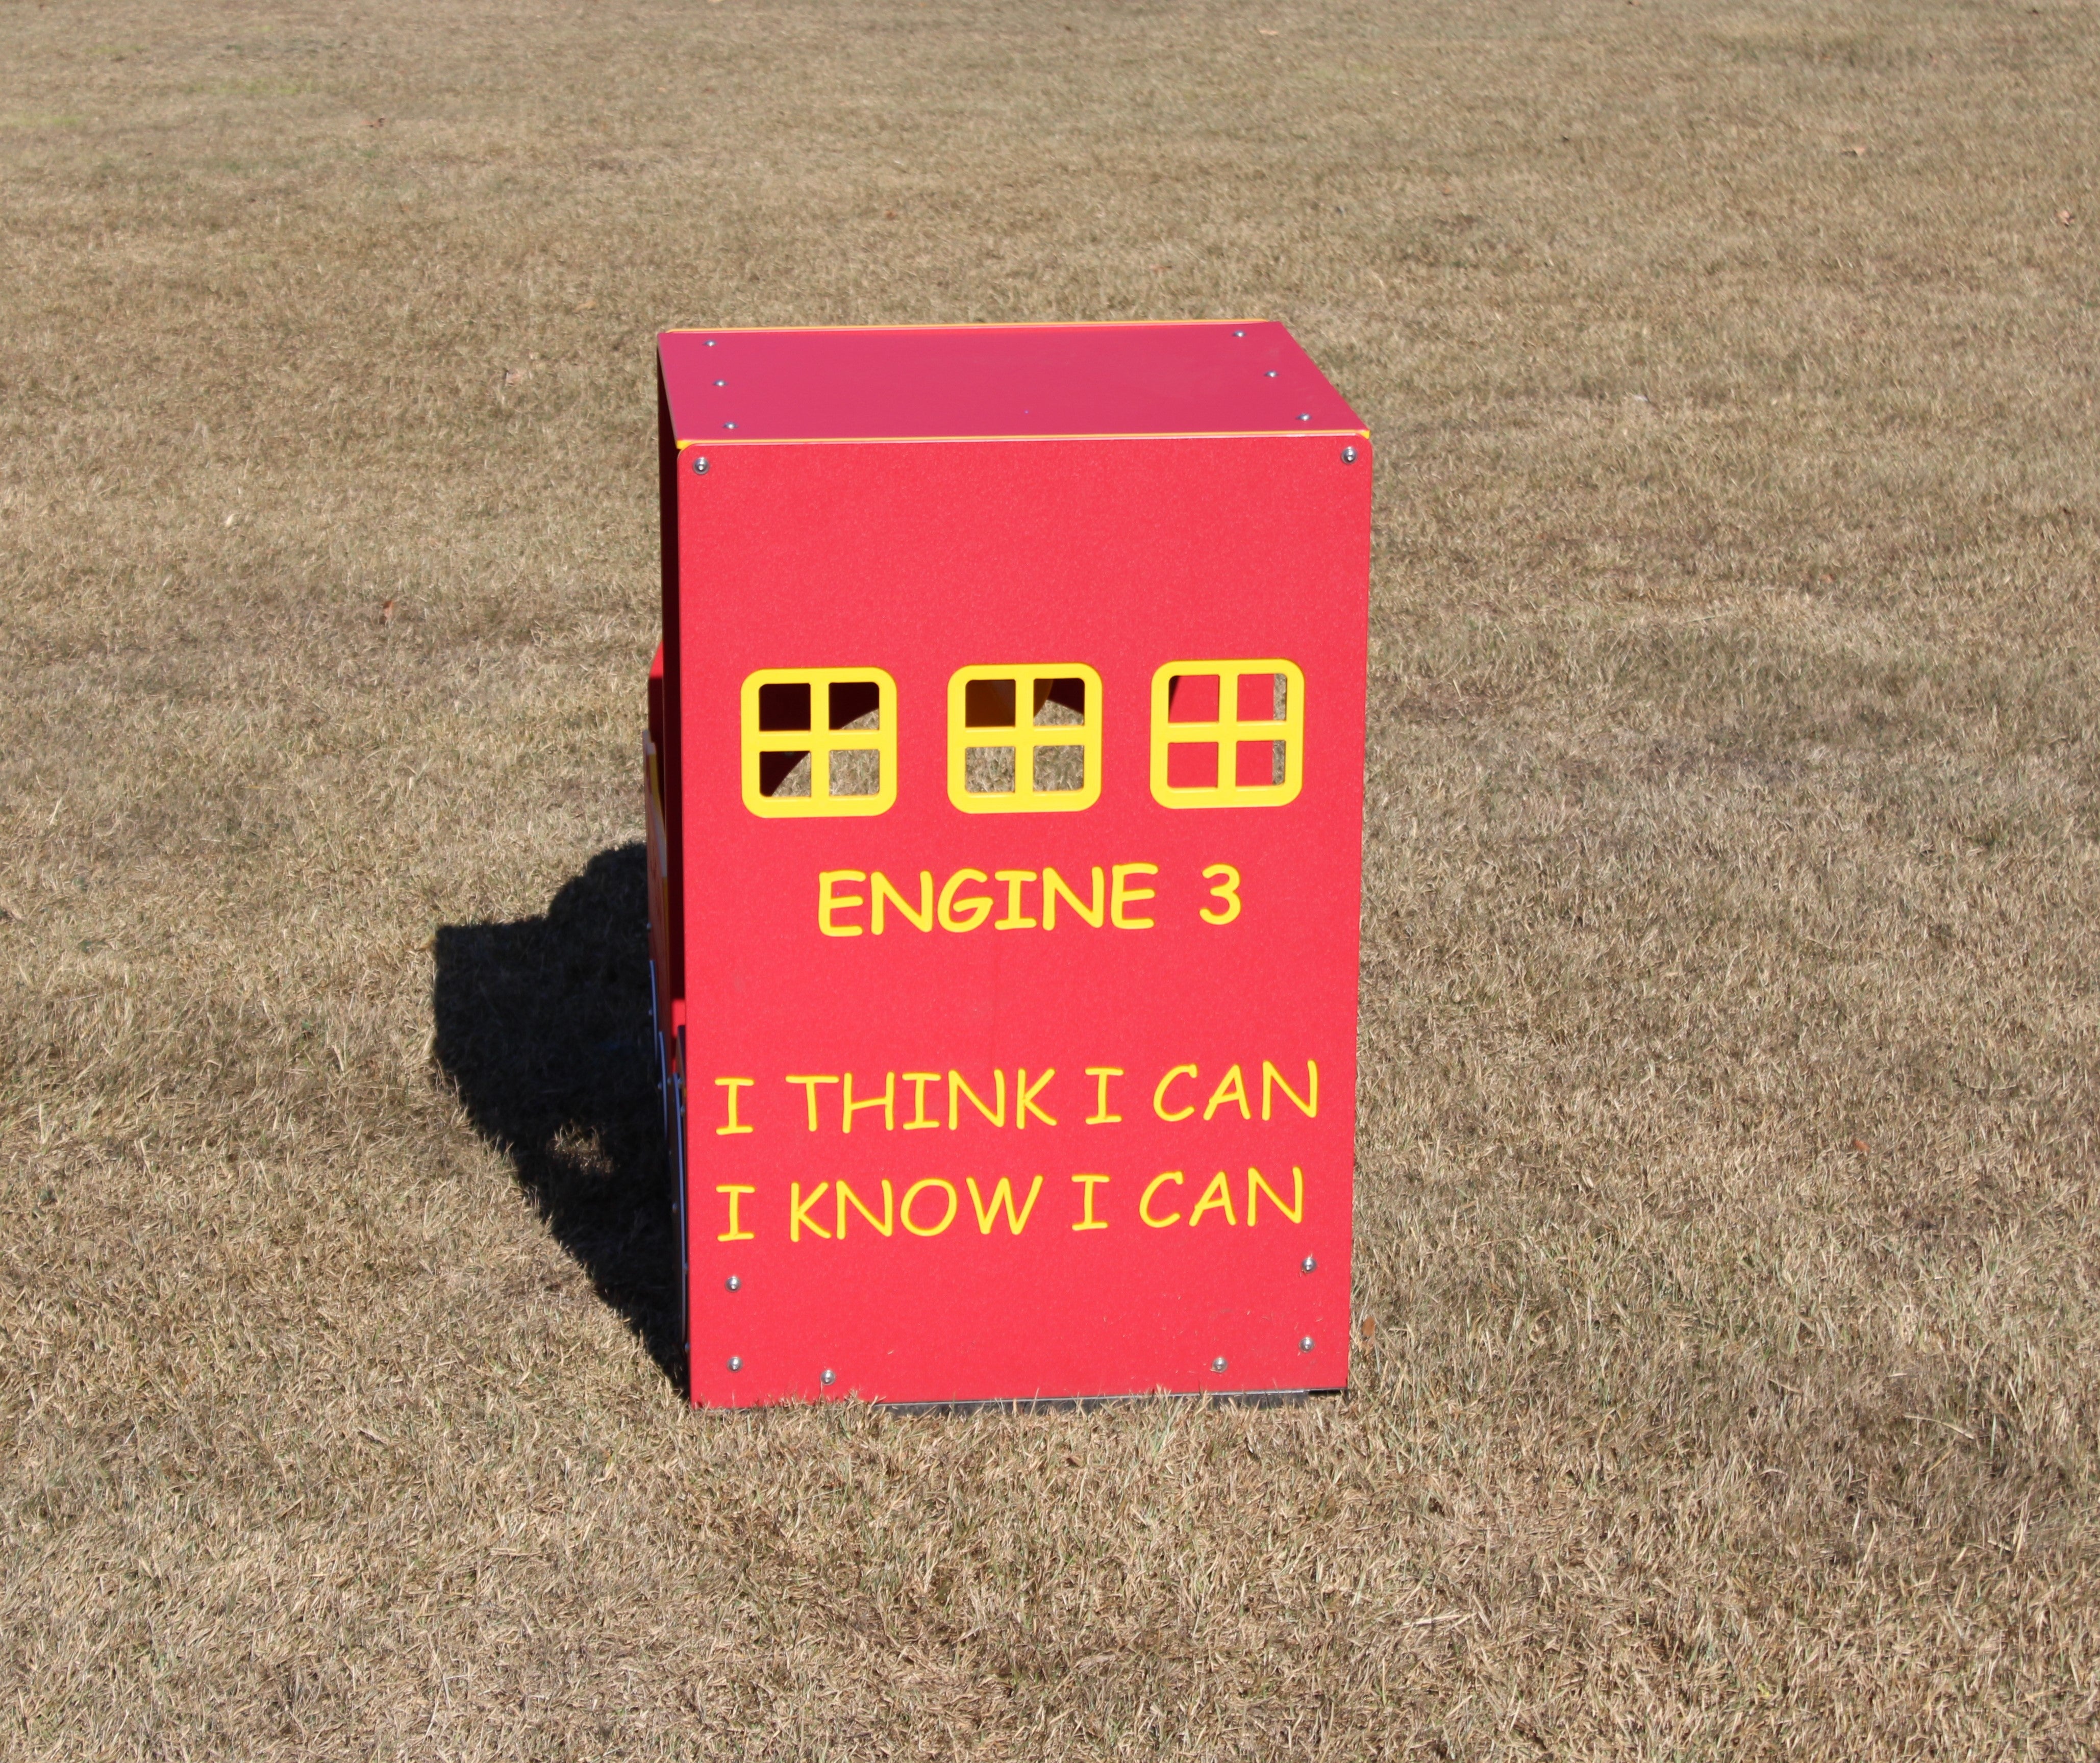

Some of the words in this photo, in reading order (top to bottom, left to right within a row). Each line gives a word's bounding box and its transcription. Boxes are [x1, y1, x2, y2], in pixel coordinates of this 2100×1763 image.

[818, 861, 1159, 937] ENGINE
[1199, 863, 1242, 925] 3
[714, 1077, 755, 1135] I
[786, 1068, 1058, 1134] THINK
[1085, 1067, 1124, 1125] I
[1153, 1060, 1318, 1122] CAN
[716, 1185, 756, 1242] I
[790, 1175, 1044, 1242] KNOW
[1071, 1174, 1111, 1230] I
[1139, 1166, 1304, 1228] CAN
